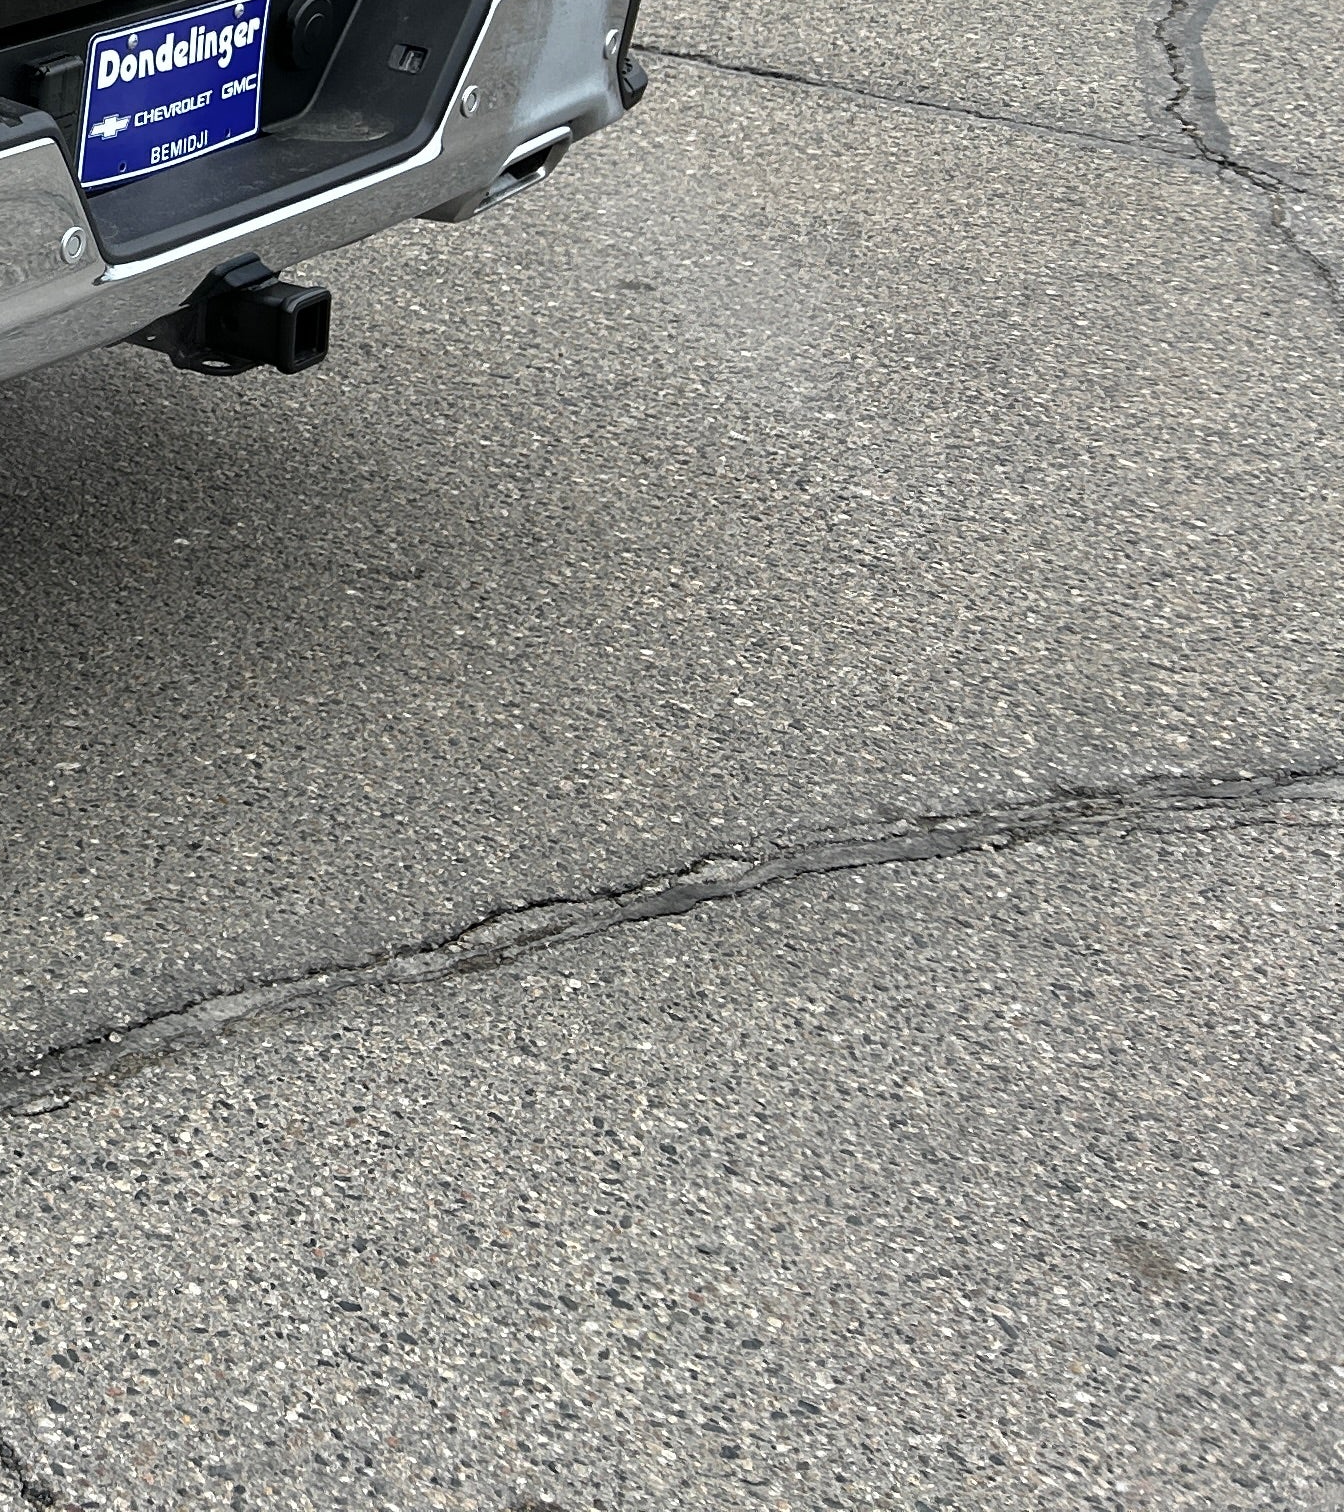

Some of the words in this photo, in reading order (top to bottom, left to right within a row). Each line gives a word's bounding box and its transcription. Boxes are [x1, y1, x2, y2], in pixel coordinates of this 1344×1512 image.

[97, 17, 261, 90] Dondelinger
[134, 90, 213, 128] CHEVROLET
[221, 74, 257, 101] GMC
[150, 129, 209, 165] BEMIDJI
